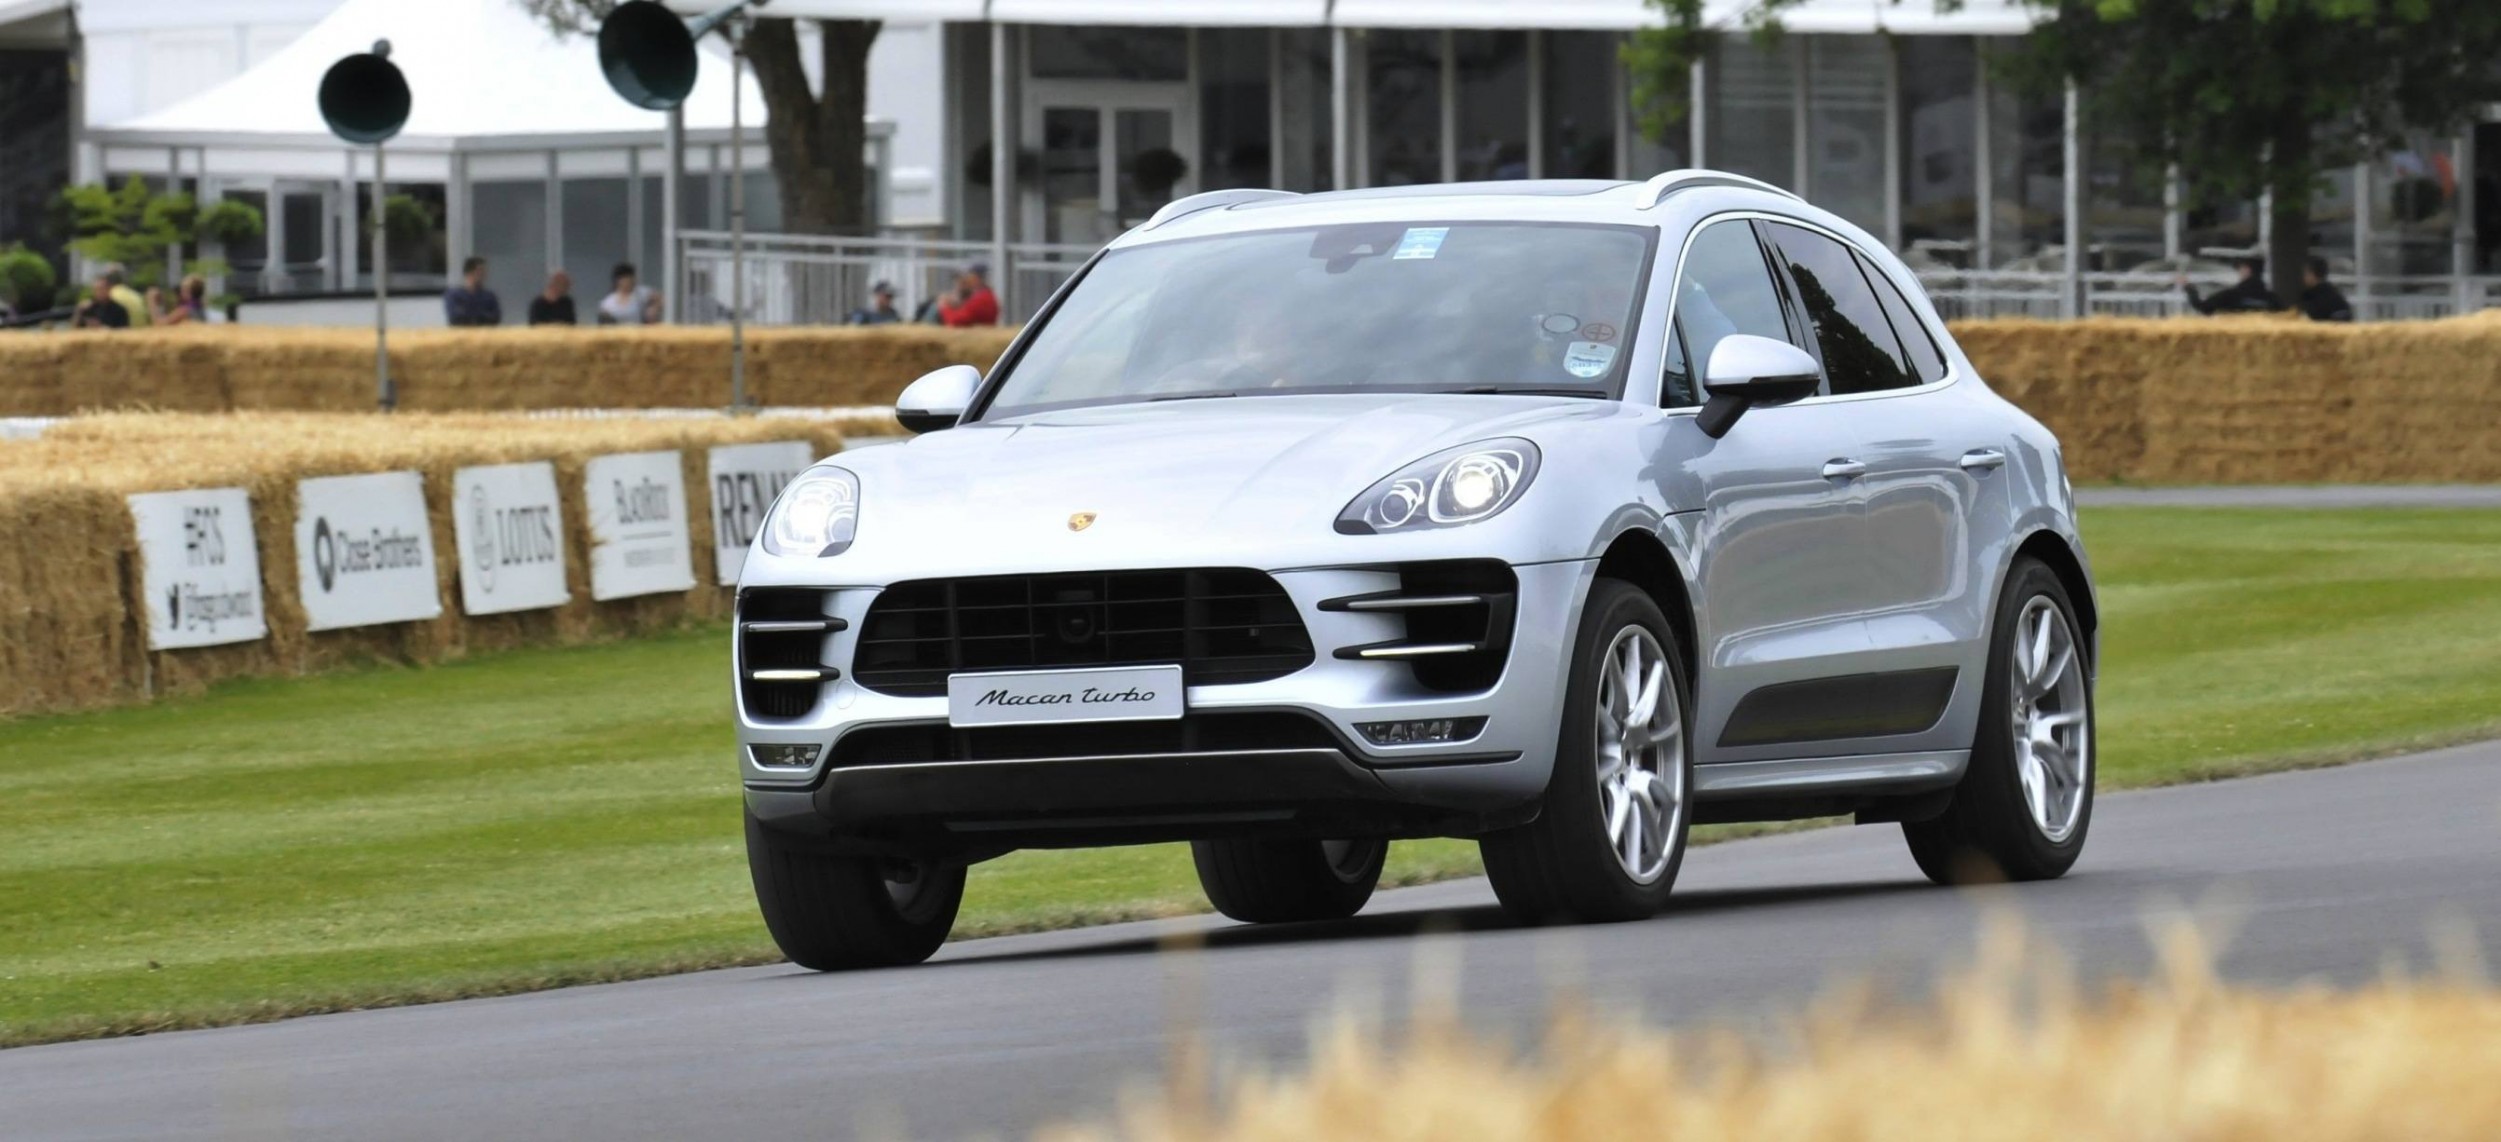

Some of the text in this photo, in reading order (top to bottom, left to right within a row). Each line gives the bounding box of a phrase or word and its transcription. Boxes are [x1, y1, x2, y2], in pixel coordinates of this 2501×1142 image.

[336, 527, 422, 573] Close Brothers
[495, 506, 555, 566] LOTUS
[974, 686, 1156, 707] Macan turbo
